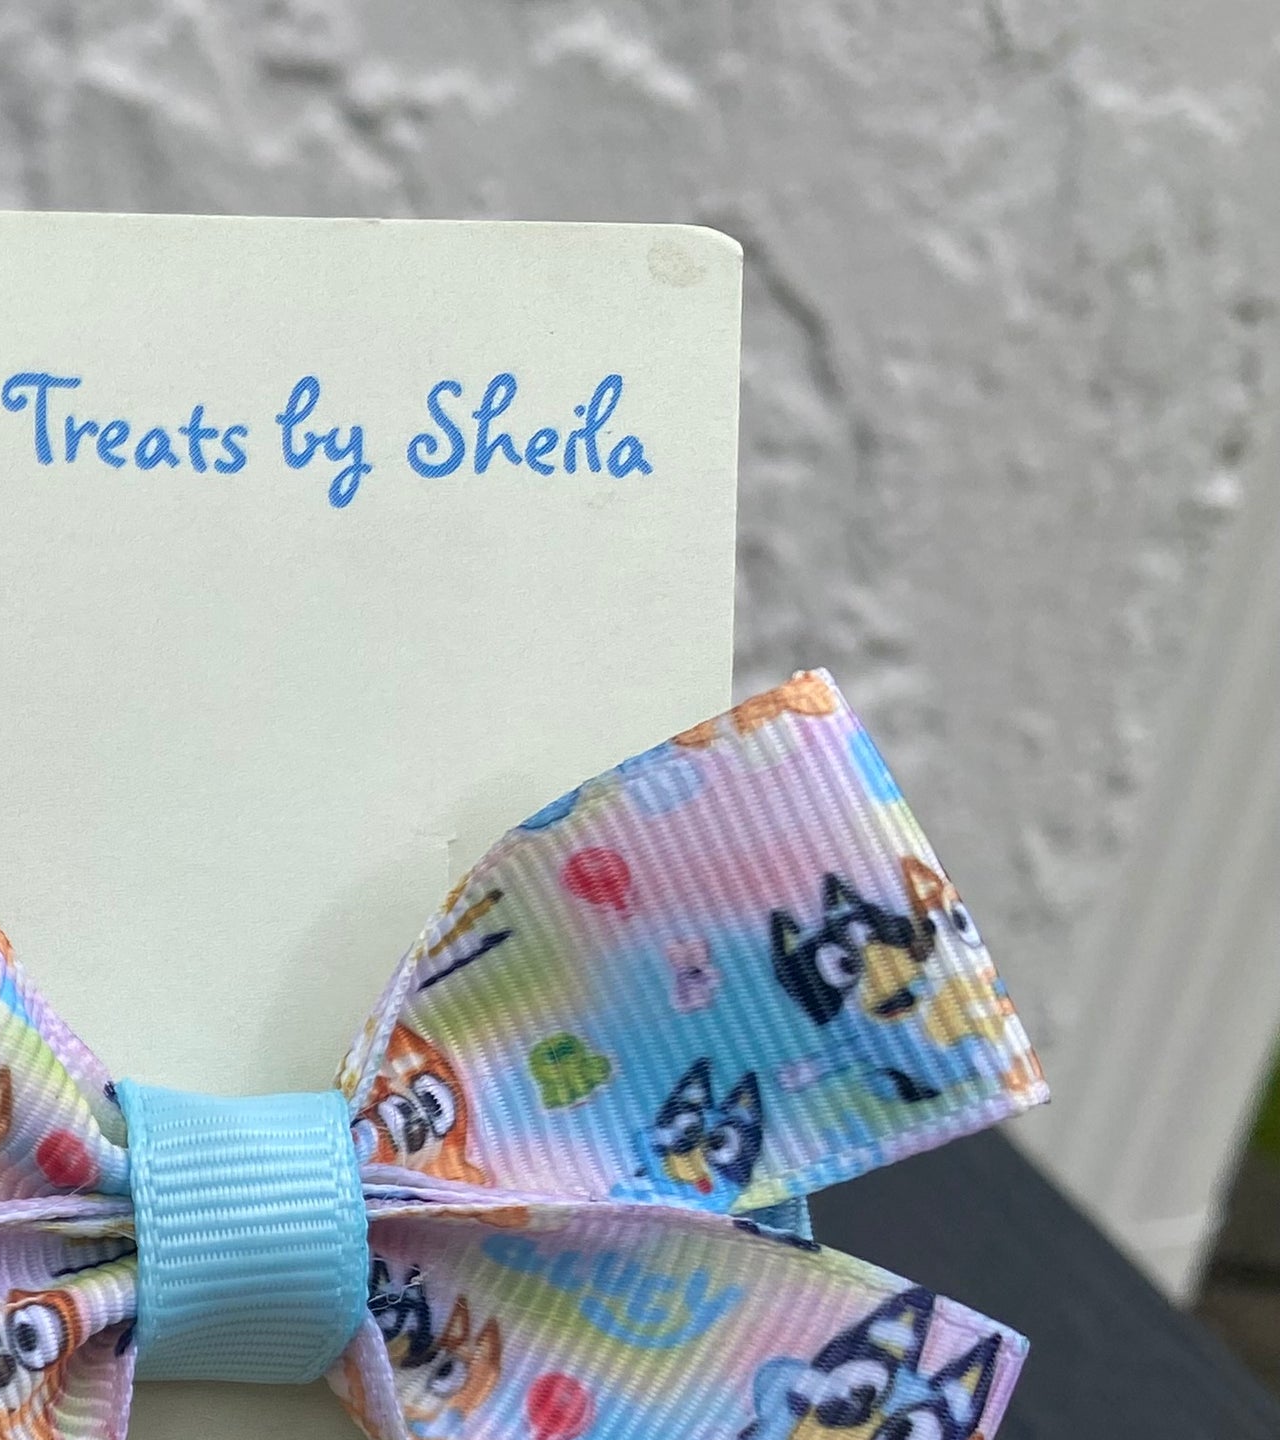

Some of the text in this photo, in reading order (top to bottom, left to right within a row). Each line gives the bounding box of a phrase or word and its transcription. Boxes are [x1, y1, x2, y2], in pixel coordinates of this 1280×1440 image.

[1, 371, 250, 475] Treats
[275, 374, 373, 509] by
[406, 372, 653, 479] Sheila
